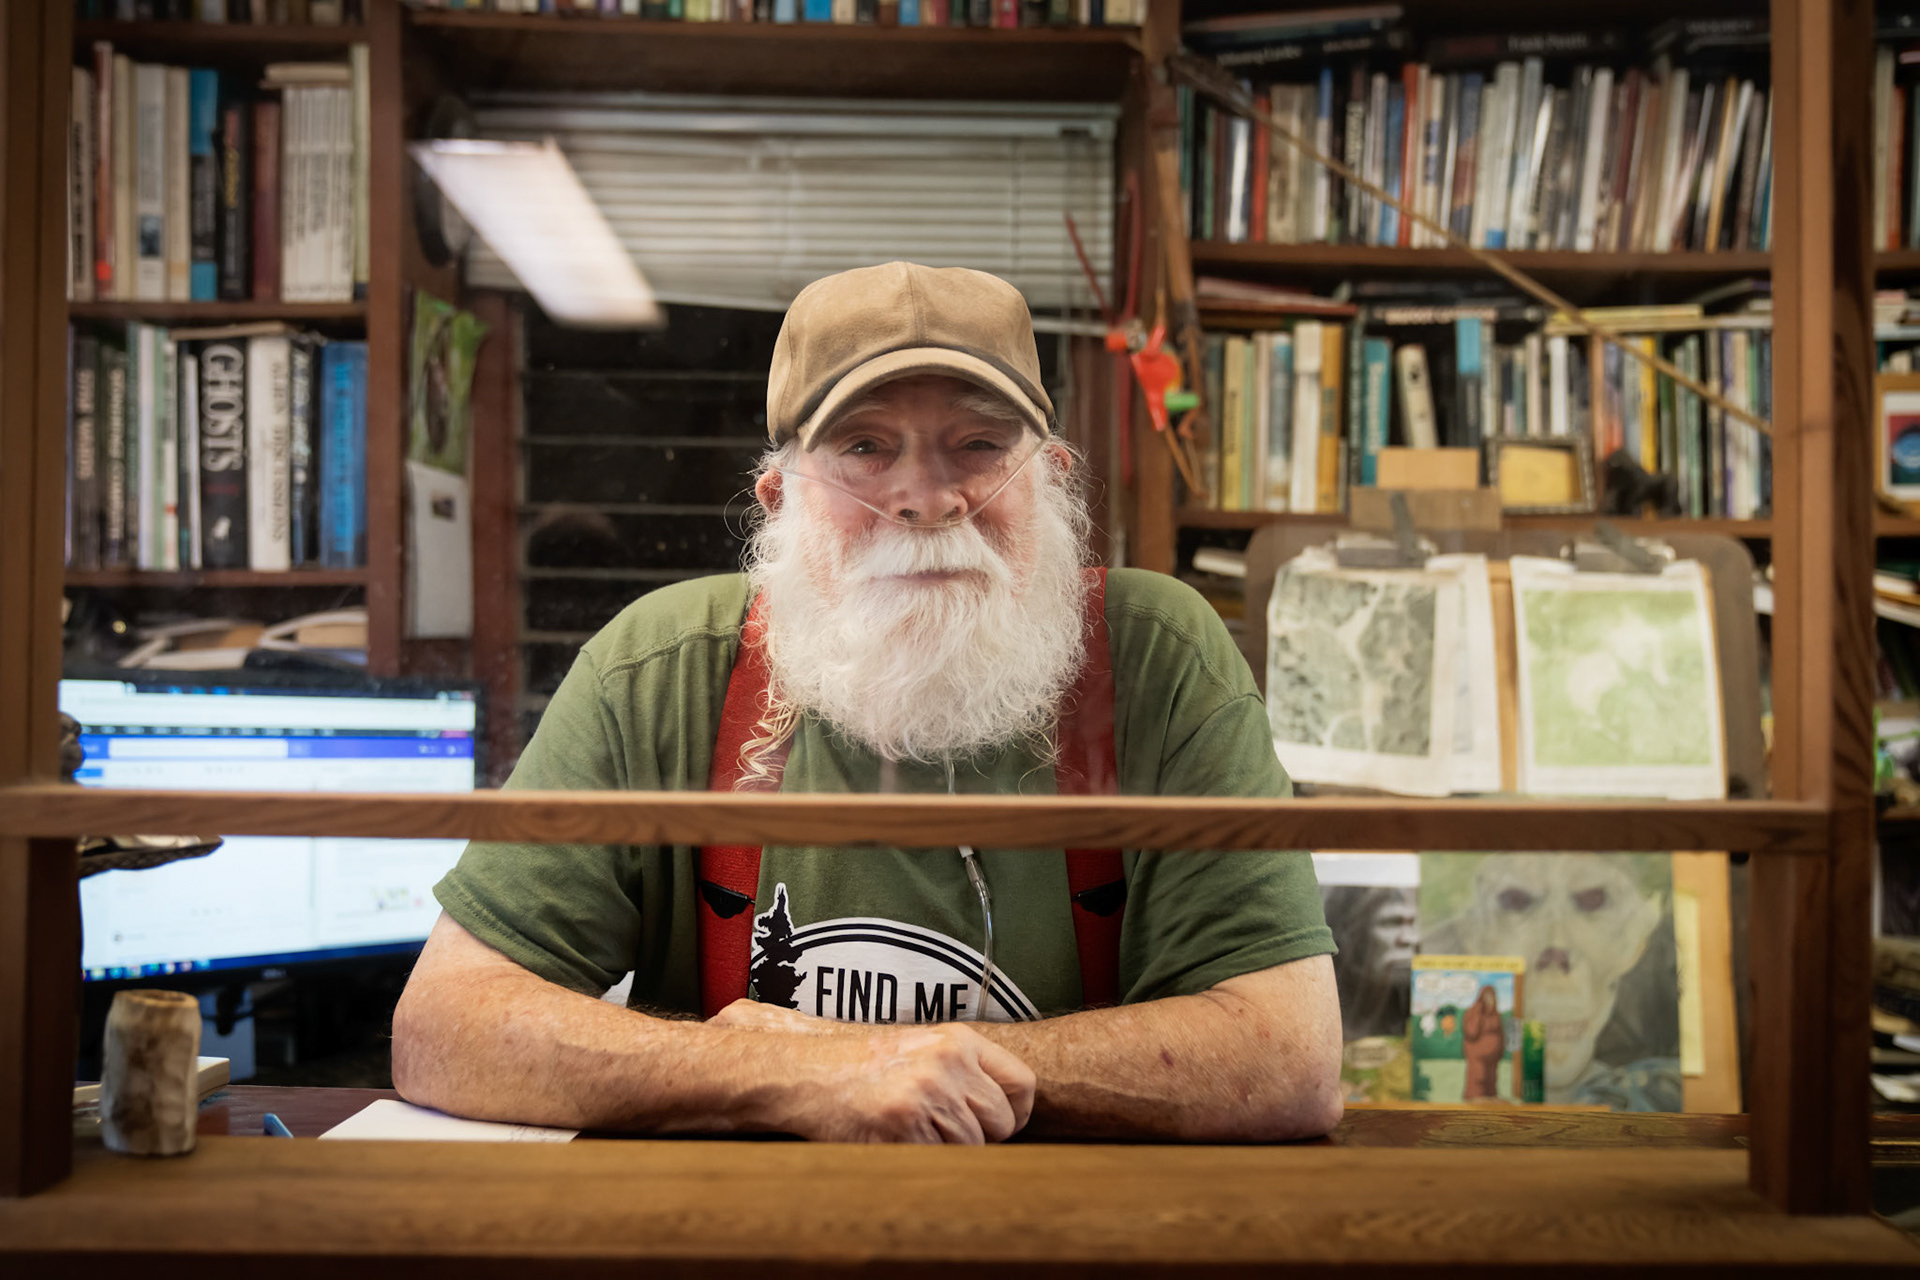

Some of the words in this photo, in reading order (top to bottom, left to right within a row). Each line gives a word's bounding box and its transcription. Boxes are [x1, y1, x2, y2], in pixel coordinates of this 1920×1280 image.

[201, 344, 244, 471] GHOSTS
[816, 966, 897, 1024] FIND
[915, 982, 968, 1024] ME
